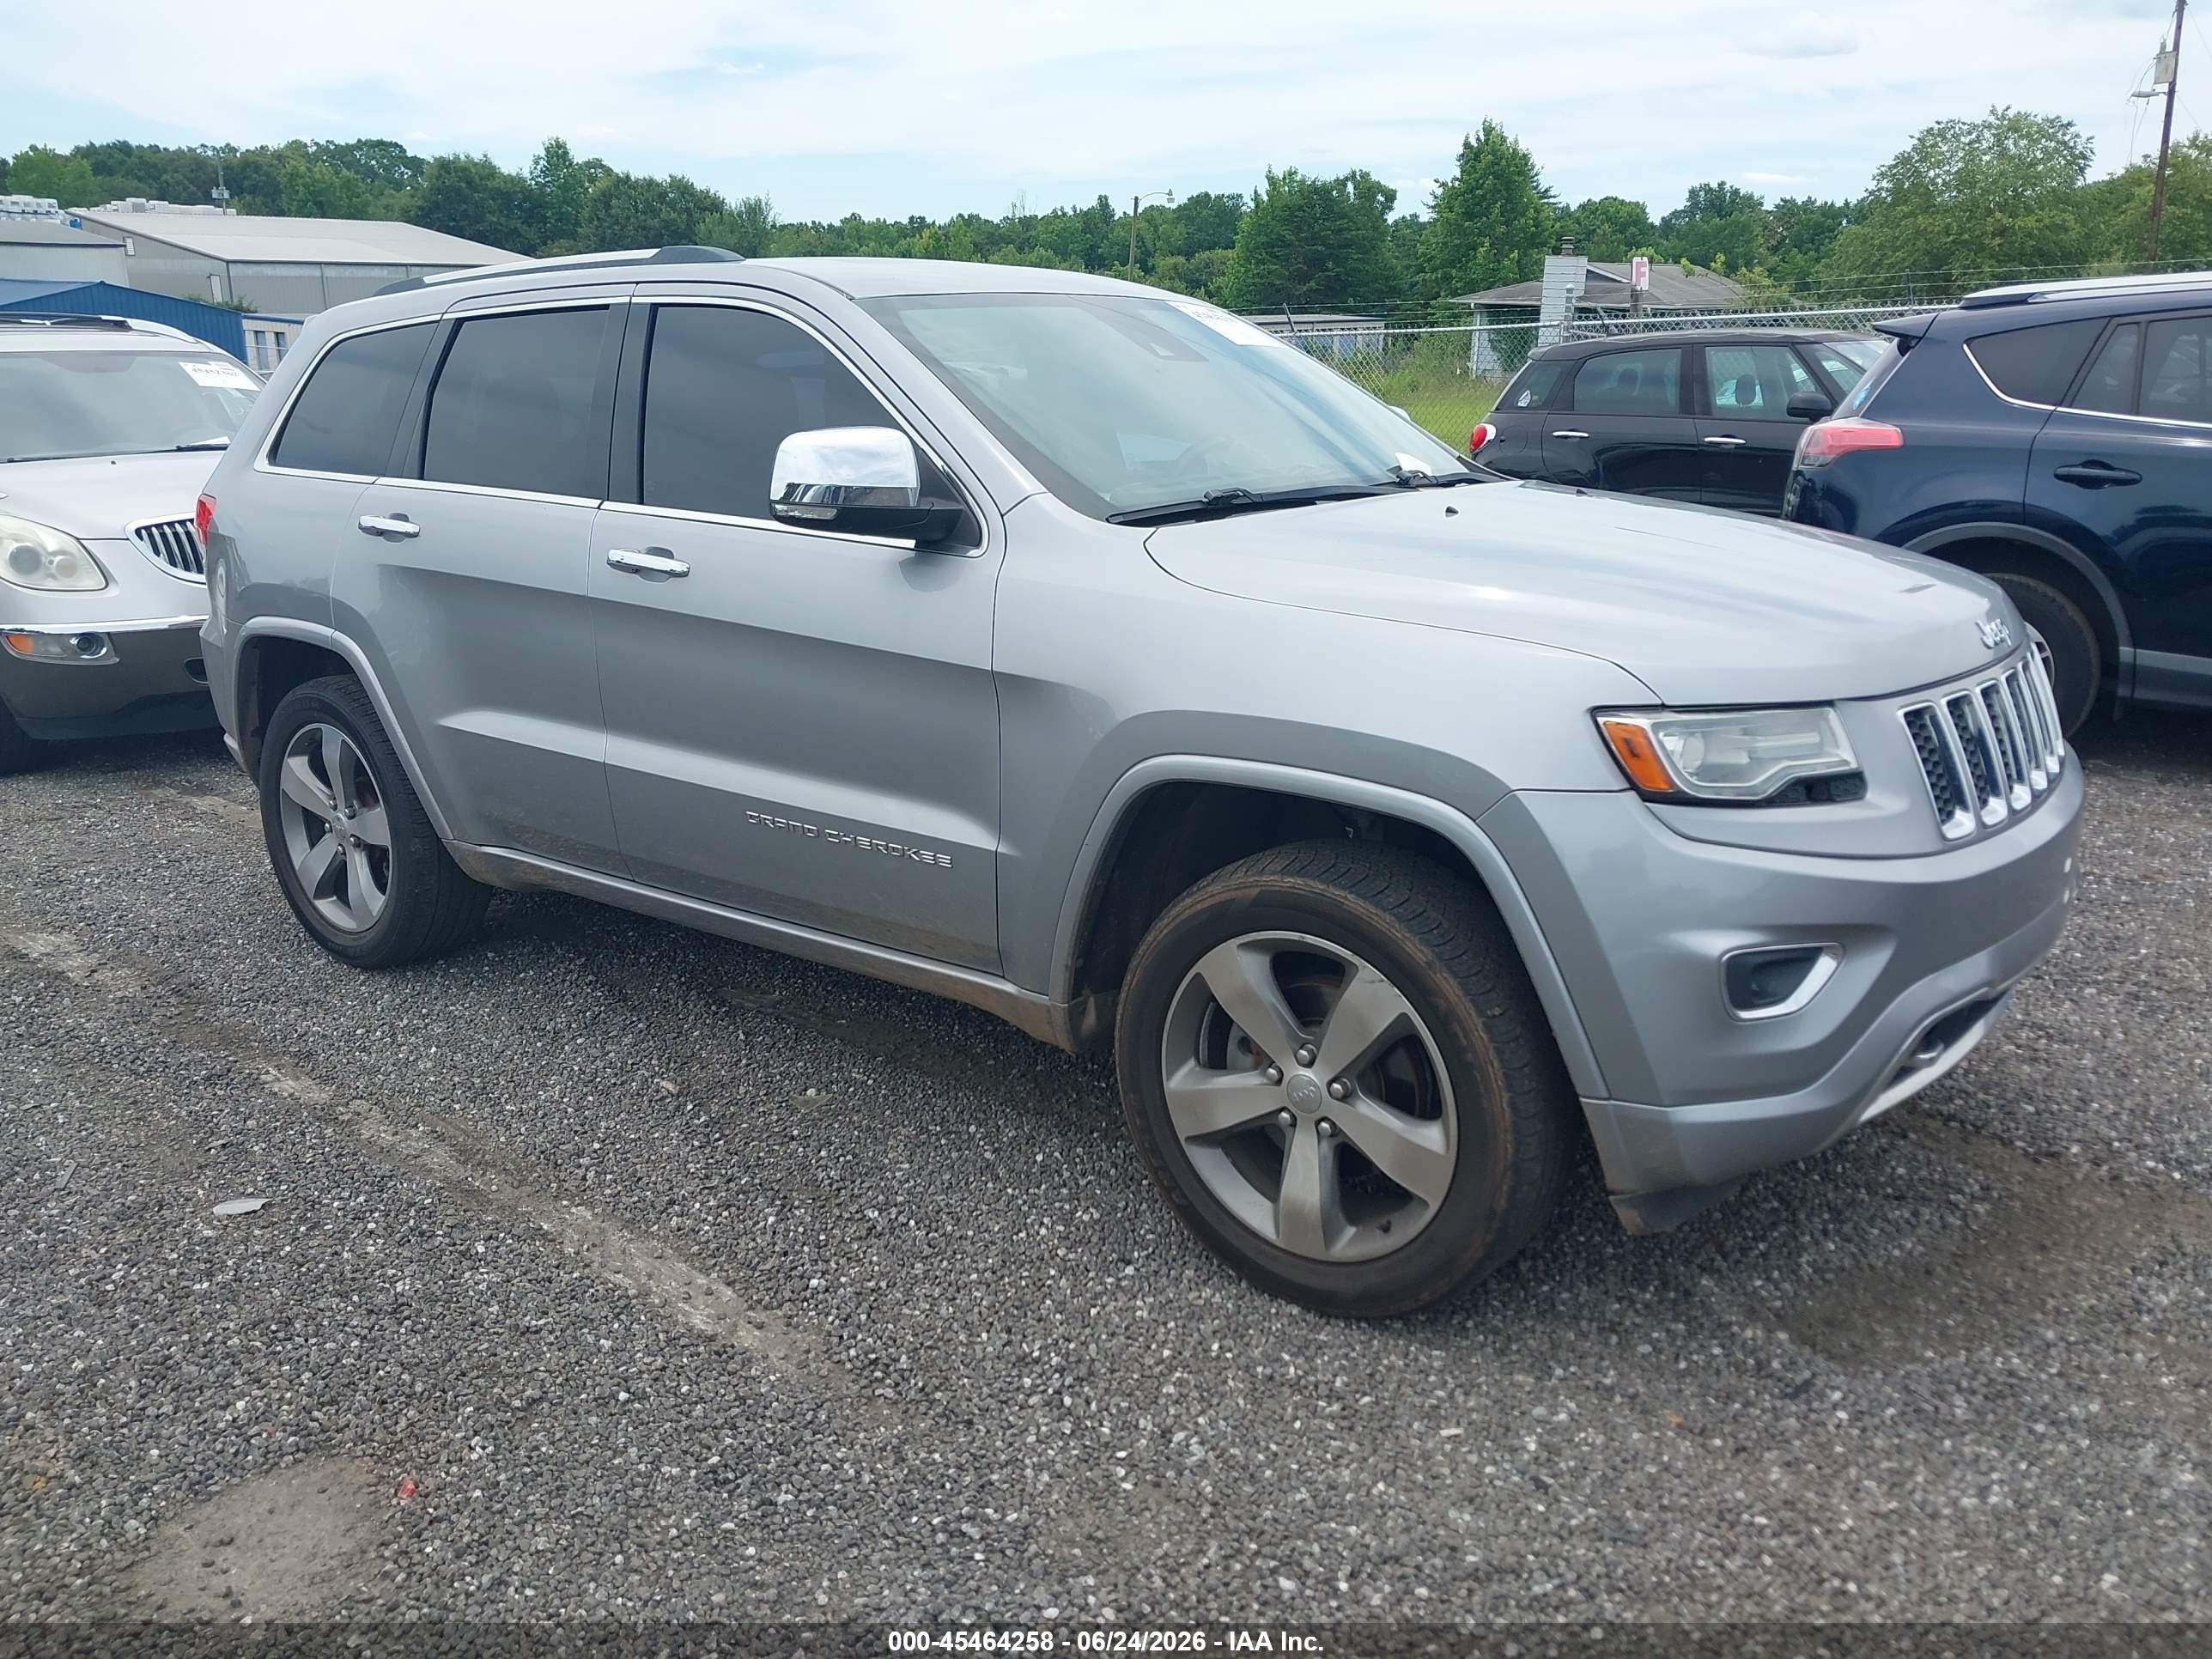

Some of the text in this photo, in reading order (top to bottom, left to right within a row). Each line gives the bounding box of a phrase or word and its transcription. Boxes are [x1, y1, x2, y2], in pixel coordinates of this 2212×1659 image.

[1976, 619, 2011, 647] Jeep
[745, 811, 953, 868] GRAND CHEROKEE
